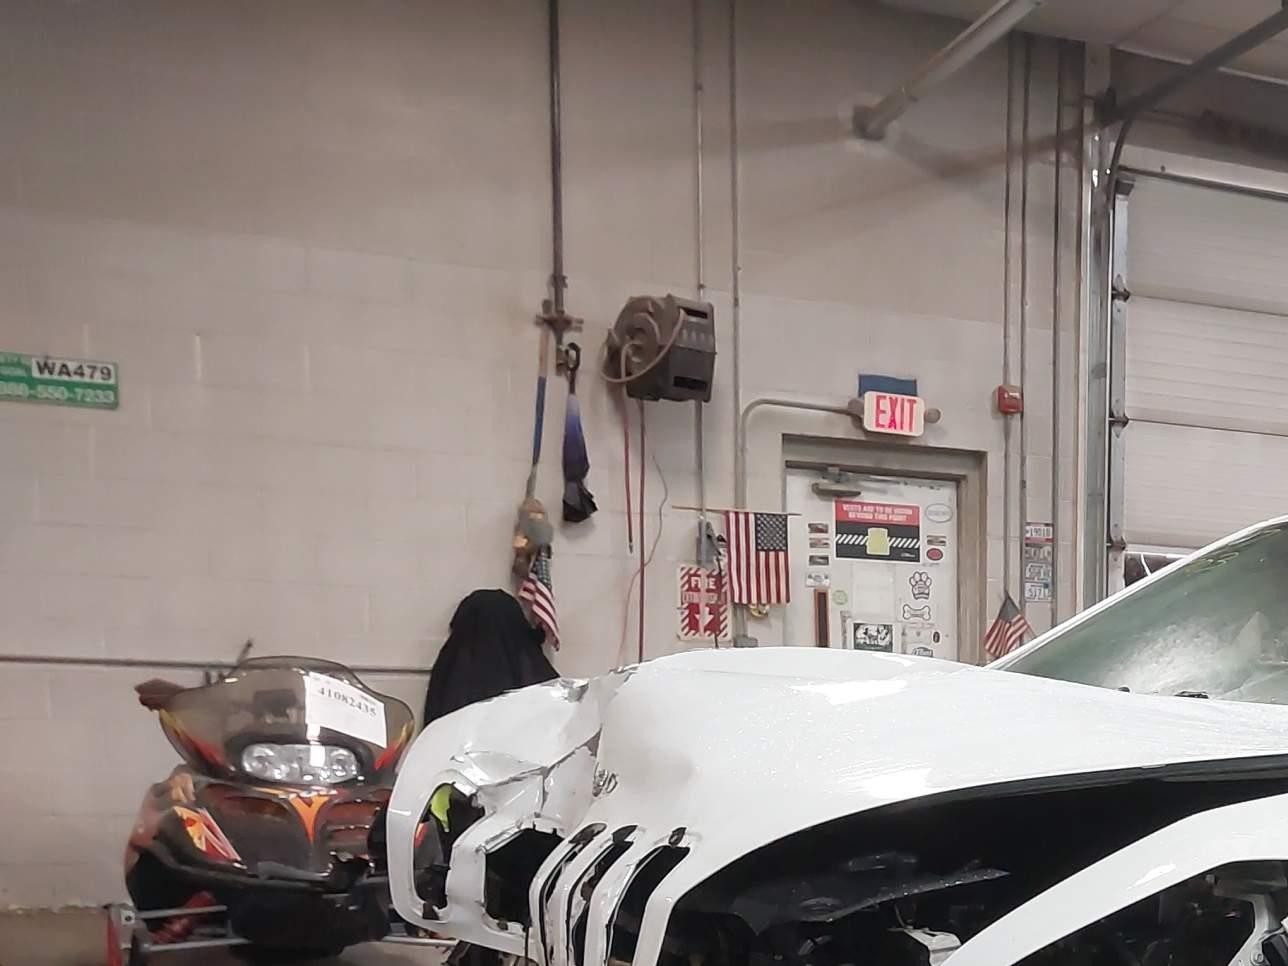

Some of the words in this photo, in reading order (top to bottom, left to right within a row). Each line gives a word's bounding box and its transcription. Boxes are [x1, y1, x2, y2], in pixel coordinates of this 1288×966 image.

[36, 360, 112, 381] WA479
[875, 394, 917, 432] EXIT
[318, 686, 378, 718] 41082435
